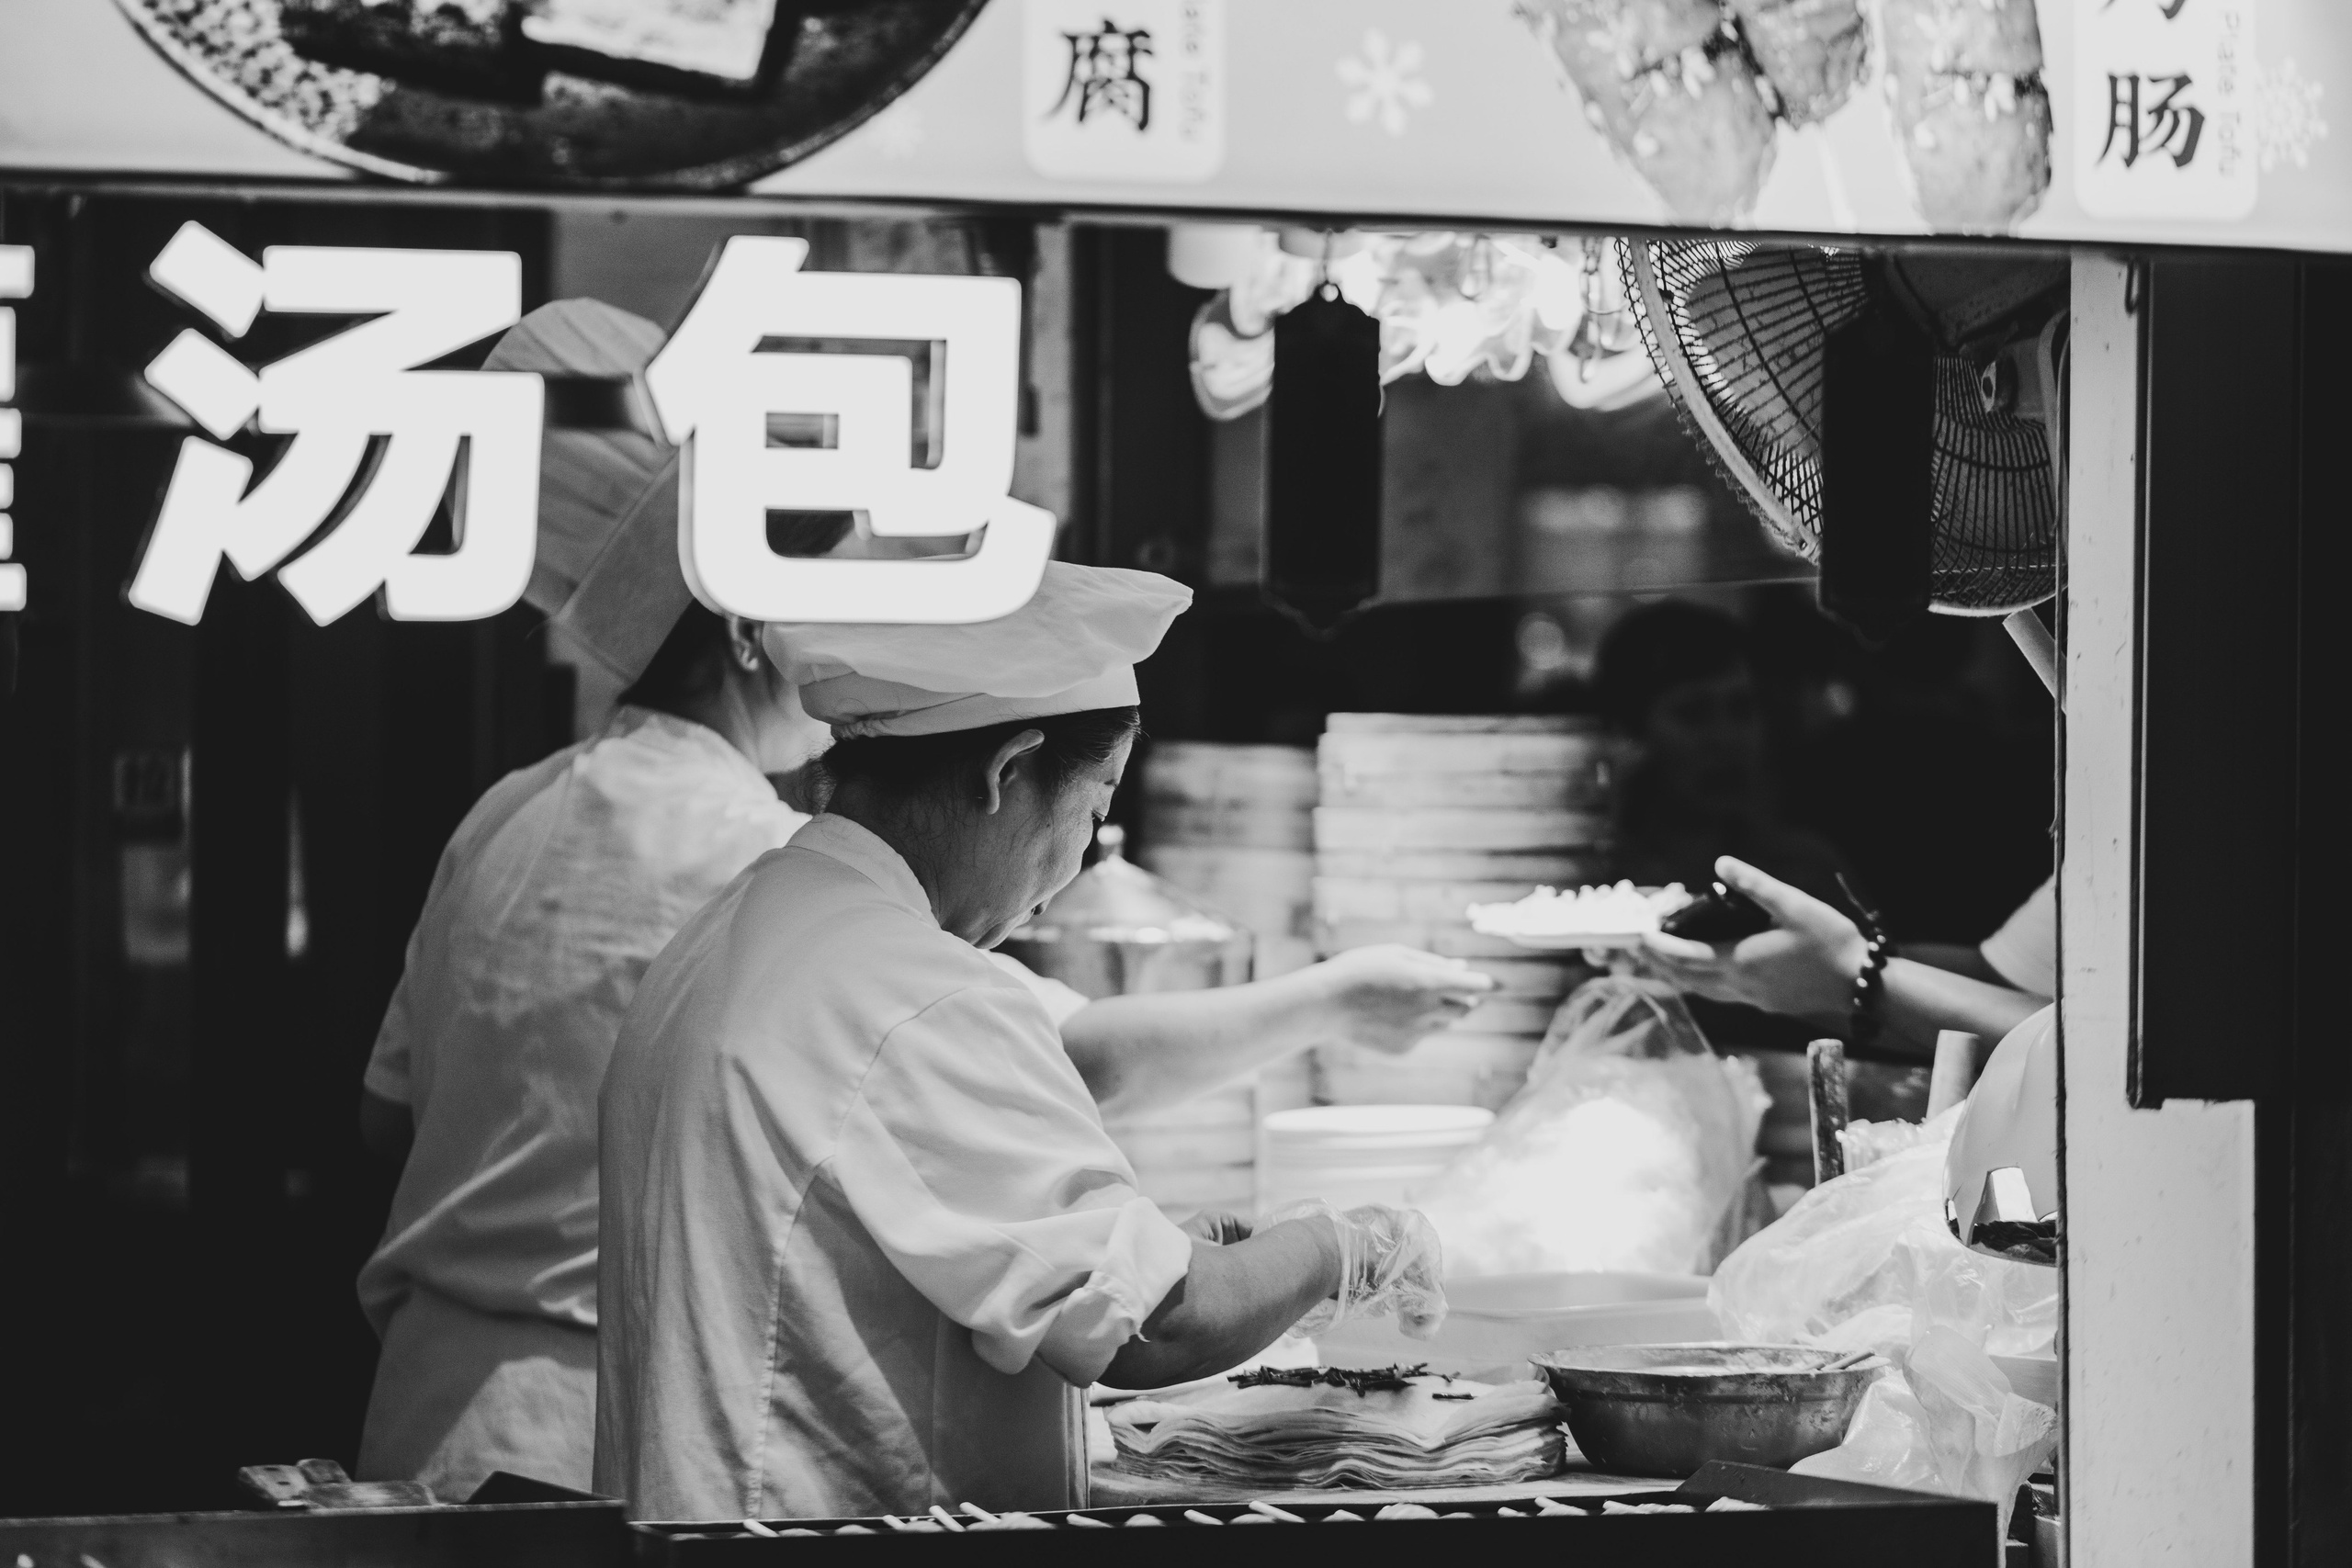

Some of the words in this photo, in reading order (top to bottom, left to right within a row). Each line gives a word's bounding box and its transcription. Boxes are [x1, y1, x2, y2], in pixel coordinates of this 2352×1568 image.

[1036, 17, 1154, 133] 腐
[2217, 110, 2242, 178] Tofu
[0, 220, 1057, 626] 汤包
